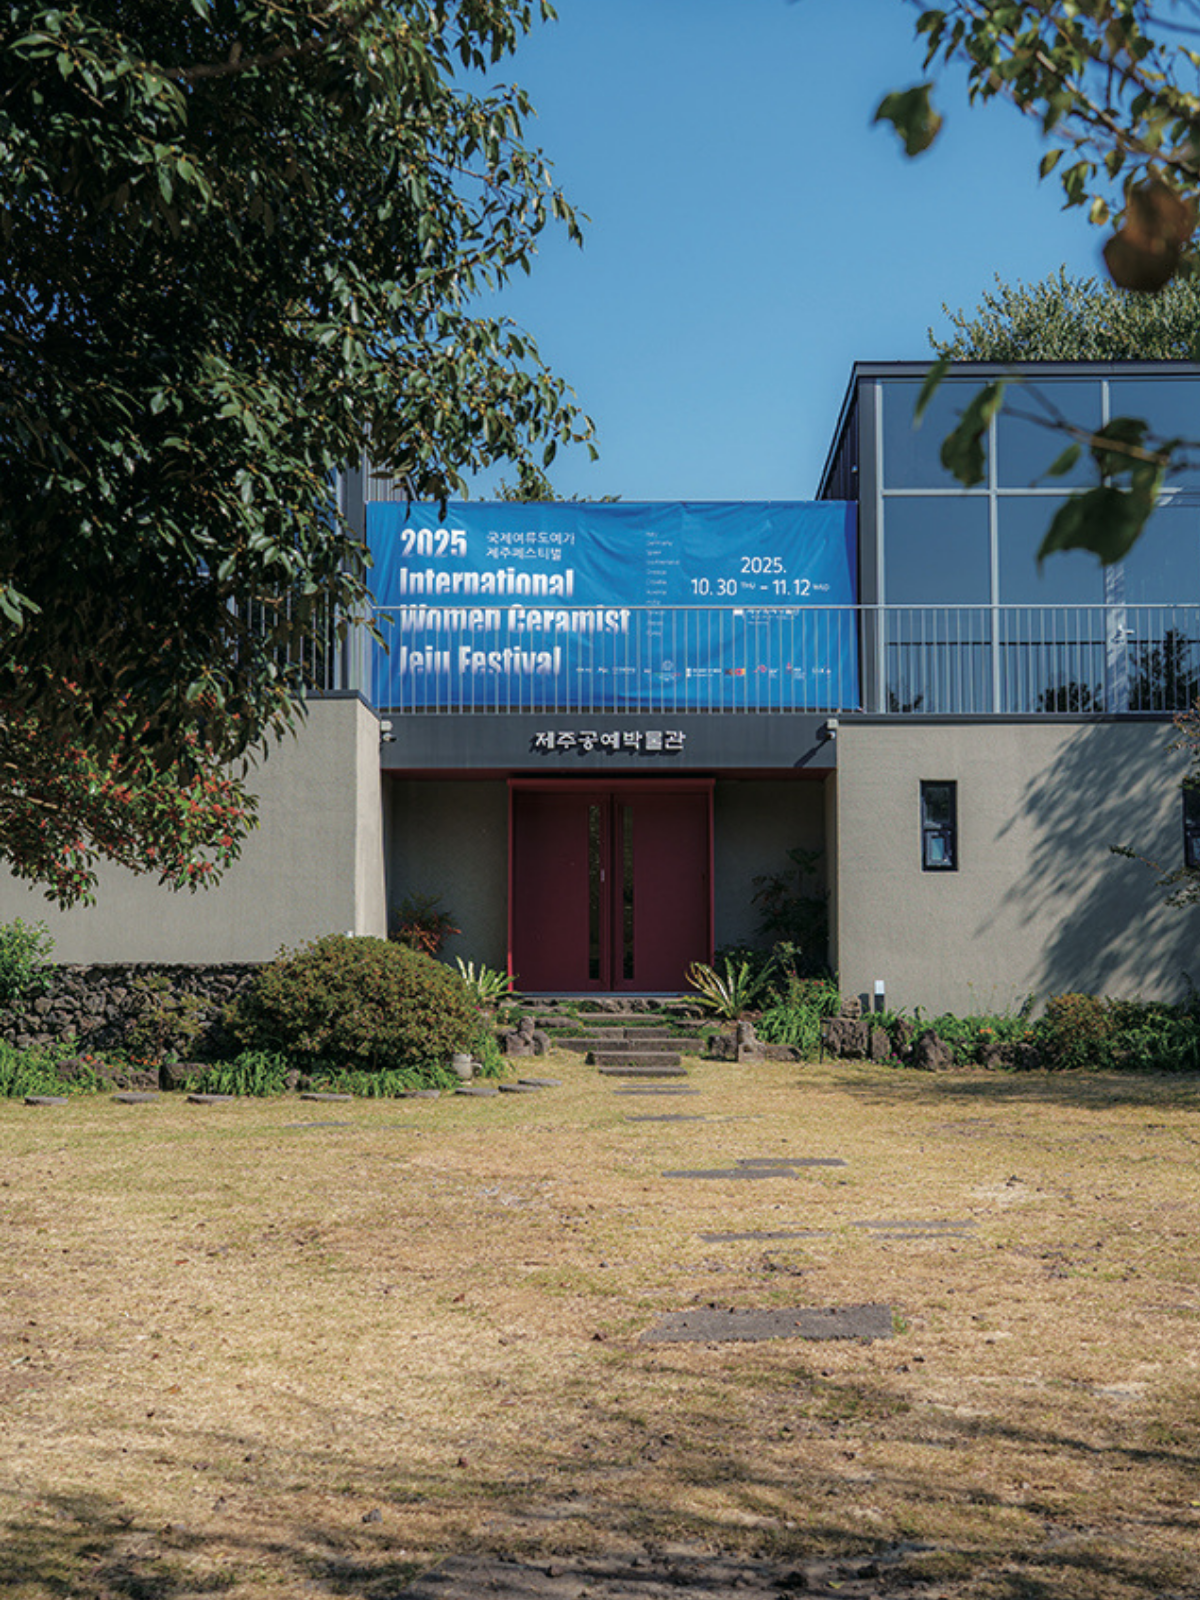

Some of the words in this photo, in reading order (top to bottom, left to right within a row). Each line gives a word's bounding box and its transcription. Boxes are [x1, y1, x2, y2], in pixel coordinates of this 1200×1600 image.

[400, 528, 467, 558] 2025
[740, 556, 787, 574] 2025.
[400, 567, 575, 597] International
[400, 603, 501, 633] Women
[507, 603, 631, 634] Ceramist
[399, 645, 451, 675] Jeju
[458, 645, 562, 676] Festival
